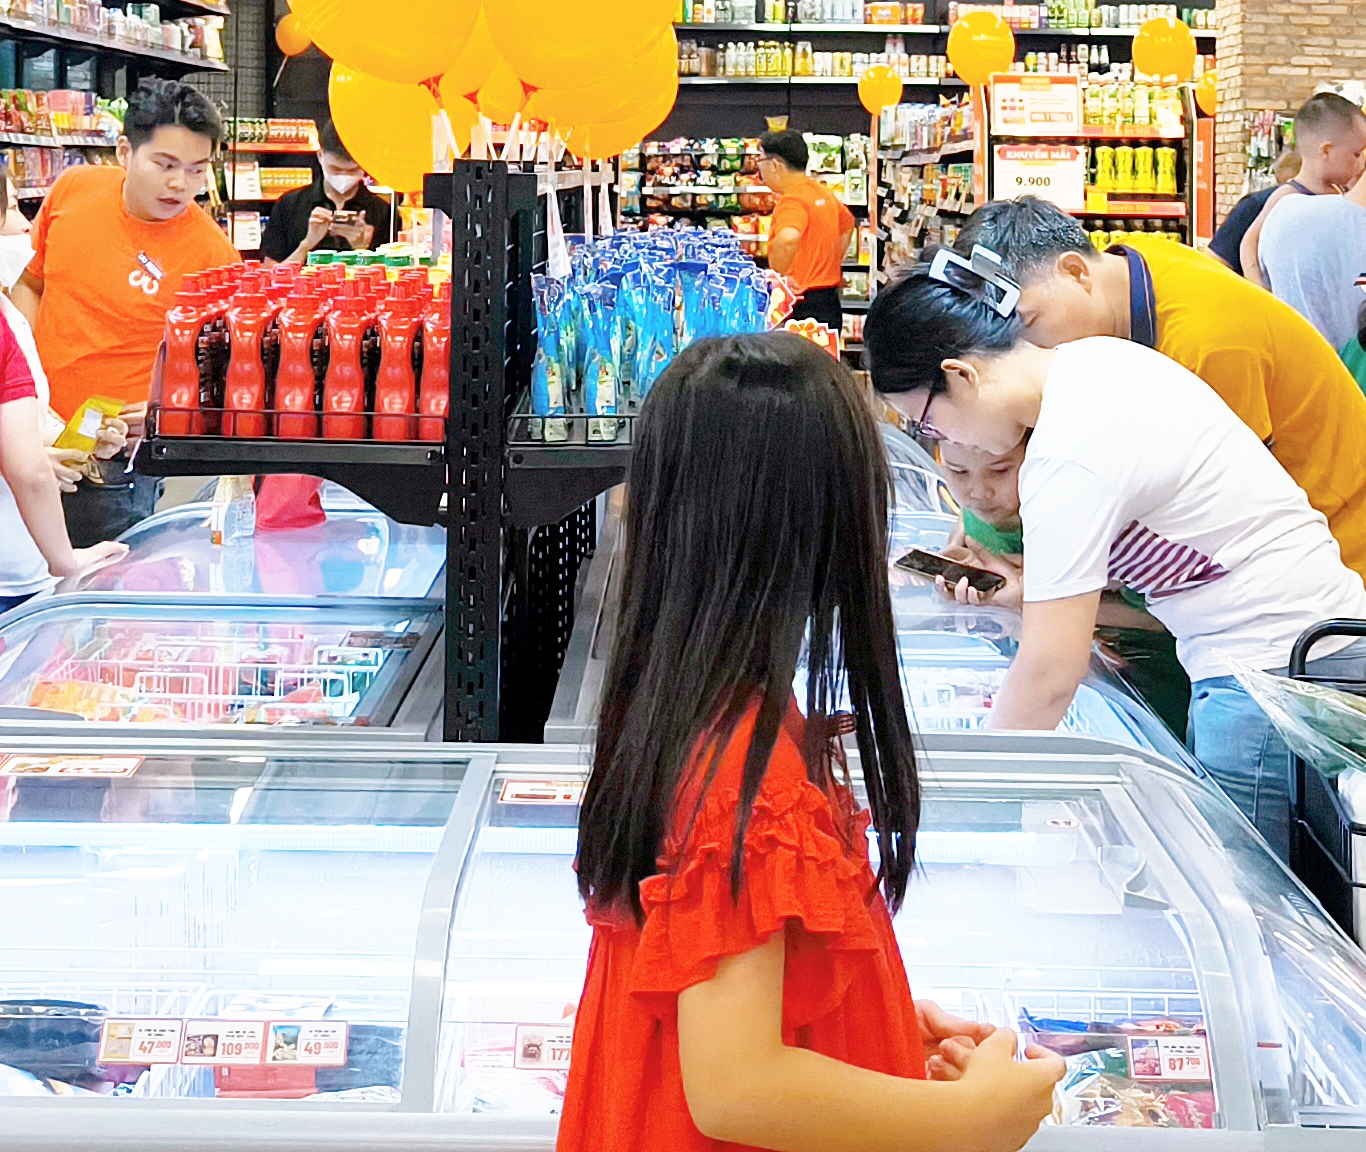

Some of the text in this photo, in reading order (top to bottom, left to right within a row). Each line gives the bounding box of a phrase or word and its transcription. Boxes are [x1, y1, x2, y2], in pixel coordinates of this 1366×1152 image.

[1015, 176, 1051, 187] 9.900
[138, 1041, 155, 1054] 47
[221, 1042, 242, 1056] 109
[304, 1041, 321, 1055] 49
[1168, 1056, 1184, 1071] 87
